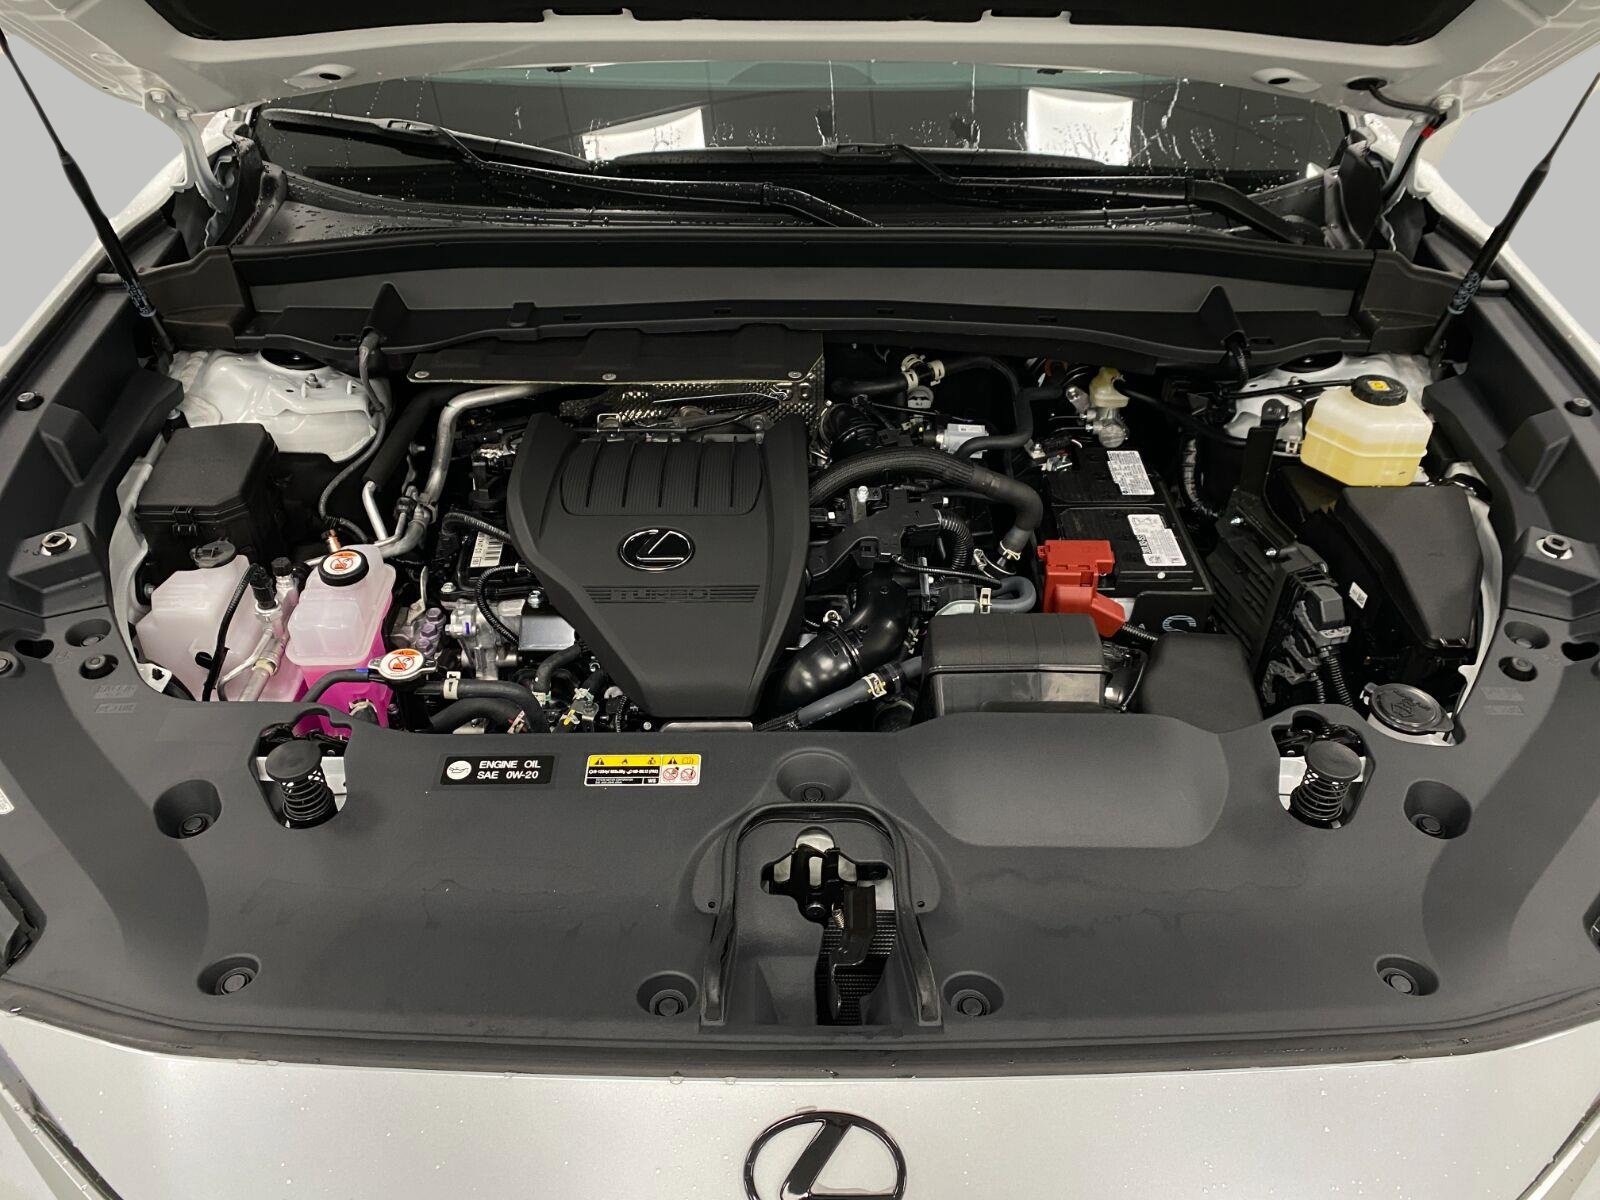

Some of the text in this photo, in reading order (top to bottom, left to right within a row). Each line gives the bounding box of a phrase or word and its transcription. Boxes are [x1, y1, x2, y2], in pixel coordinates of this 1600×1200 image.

[613, 589, 708, 600] TURBO
[479, 760, 541, 769] ENGINE OIL
[477, 770, 539, 779] SAE 0W-20
